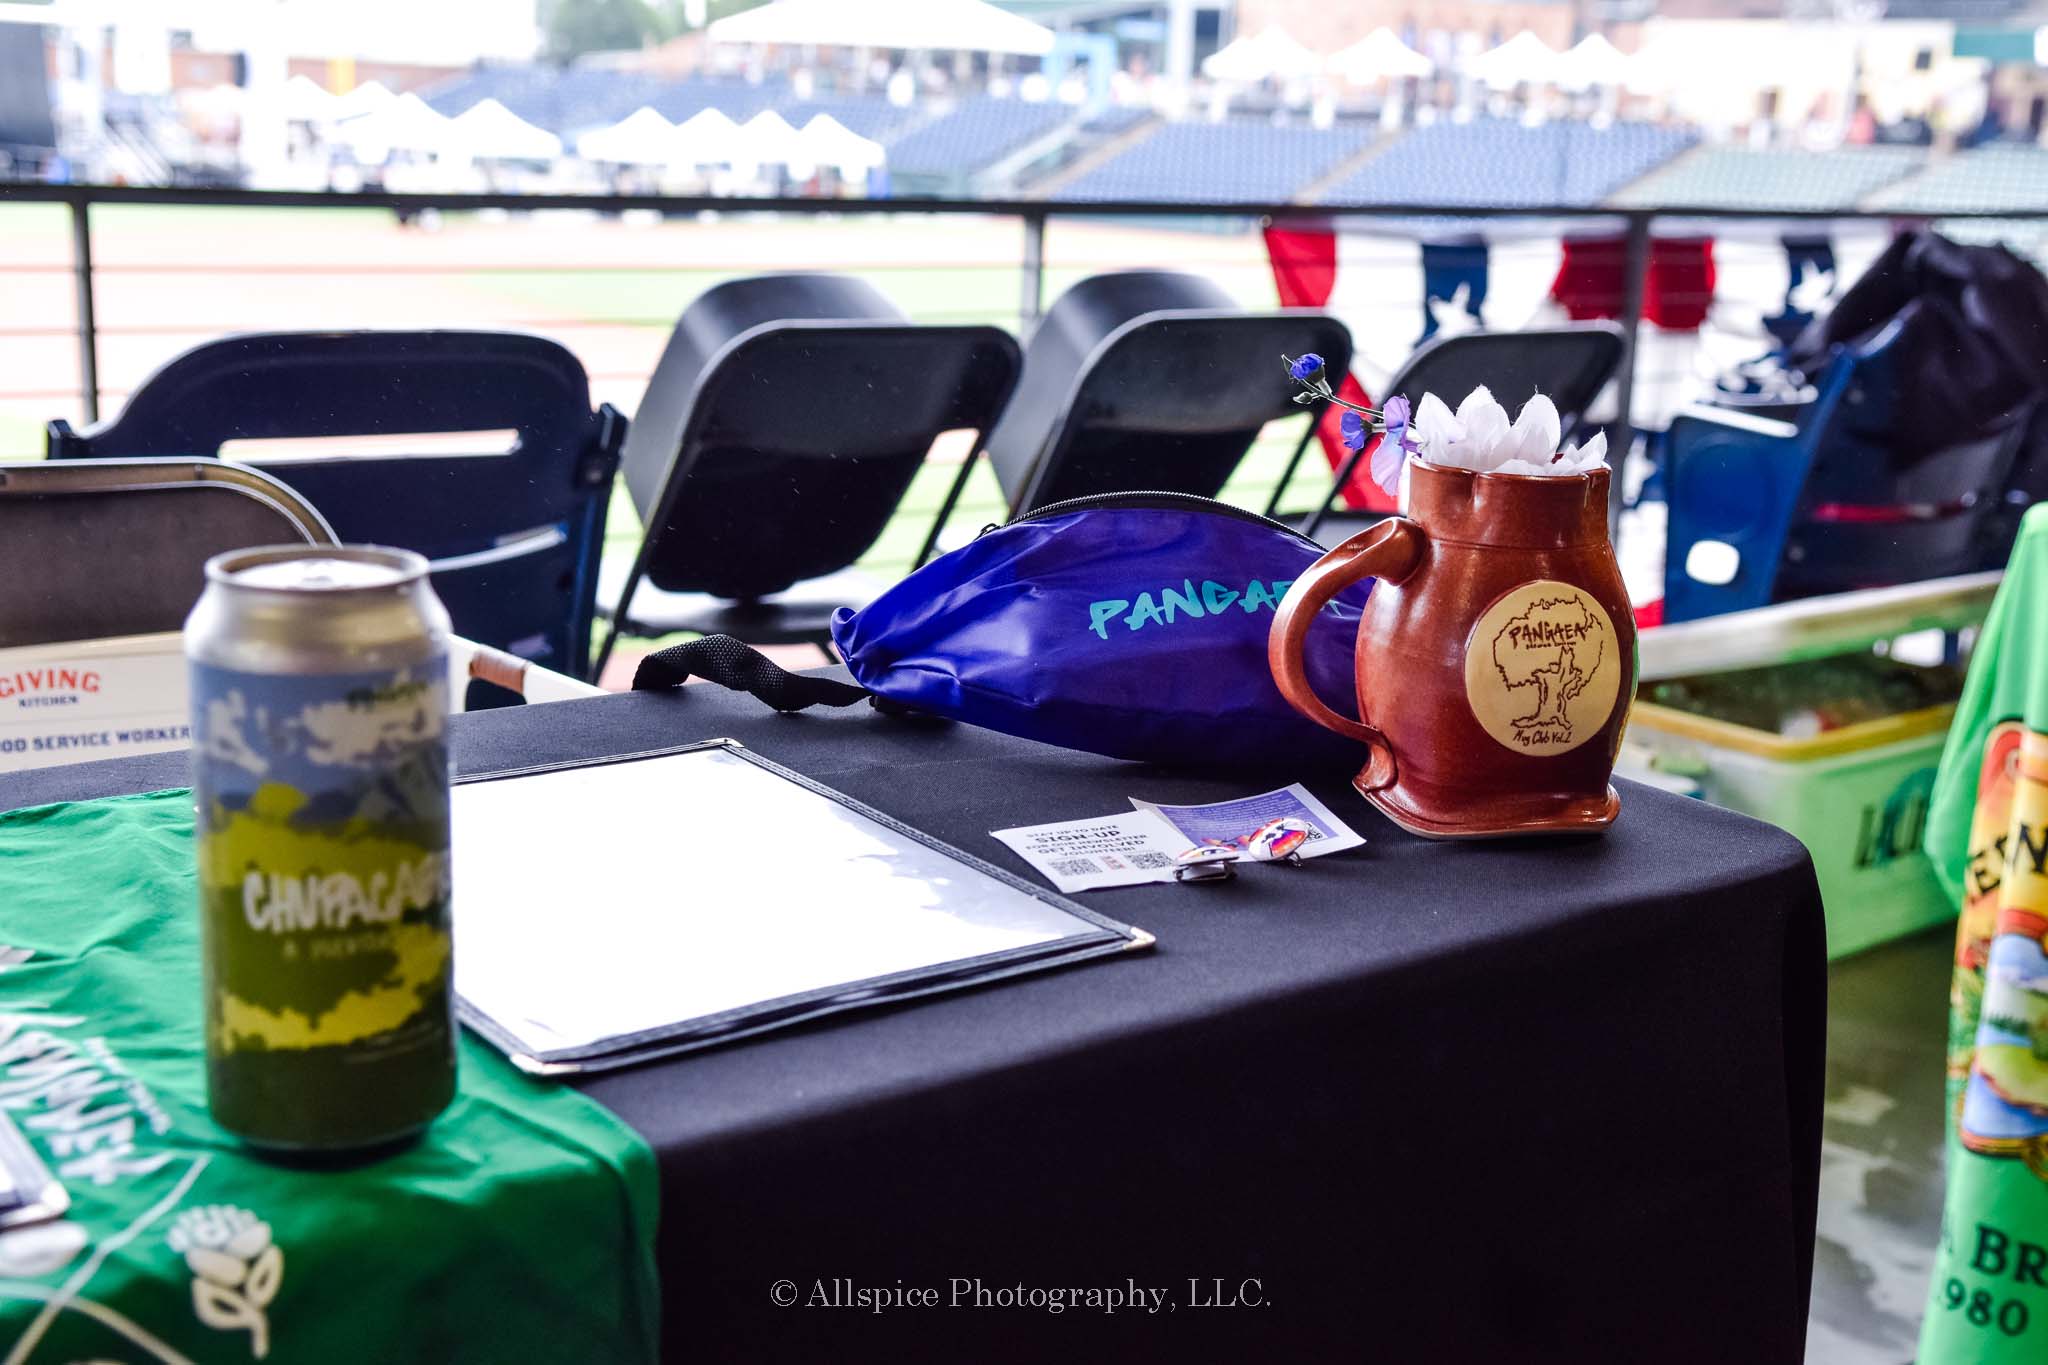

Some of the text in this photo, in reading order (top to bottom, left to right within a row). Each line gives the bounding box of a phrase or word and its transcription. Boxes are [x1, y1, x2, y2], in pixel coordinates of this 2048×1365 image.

[1089, 578, 1341, 640] PANGAE
[1509, 621, 1586, 650] PANGAEA
[0, 668, 101, 698] GIVING
[32, 732, 110, 750] SERVICE
[1513, 730, 1531, 747] Mug
[1532, 730, 1550, 745] Club
[1026, 830, 1052, 838] STAY
[1091, 824, 1119, 832] DATE
[1035, 830, 1121, 844] SIGN-UP
[1051, 840, 1076, 848] OUR
[1078, 834, 1147, 846] NEWSLETTER
[1070, 840, 1145, 852] INVOLVED
[1938, 1276, 2030, 1337] 980
